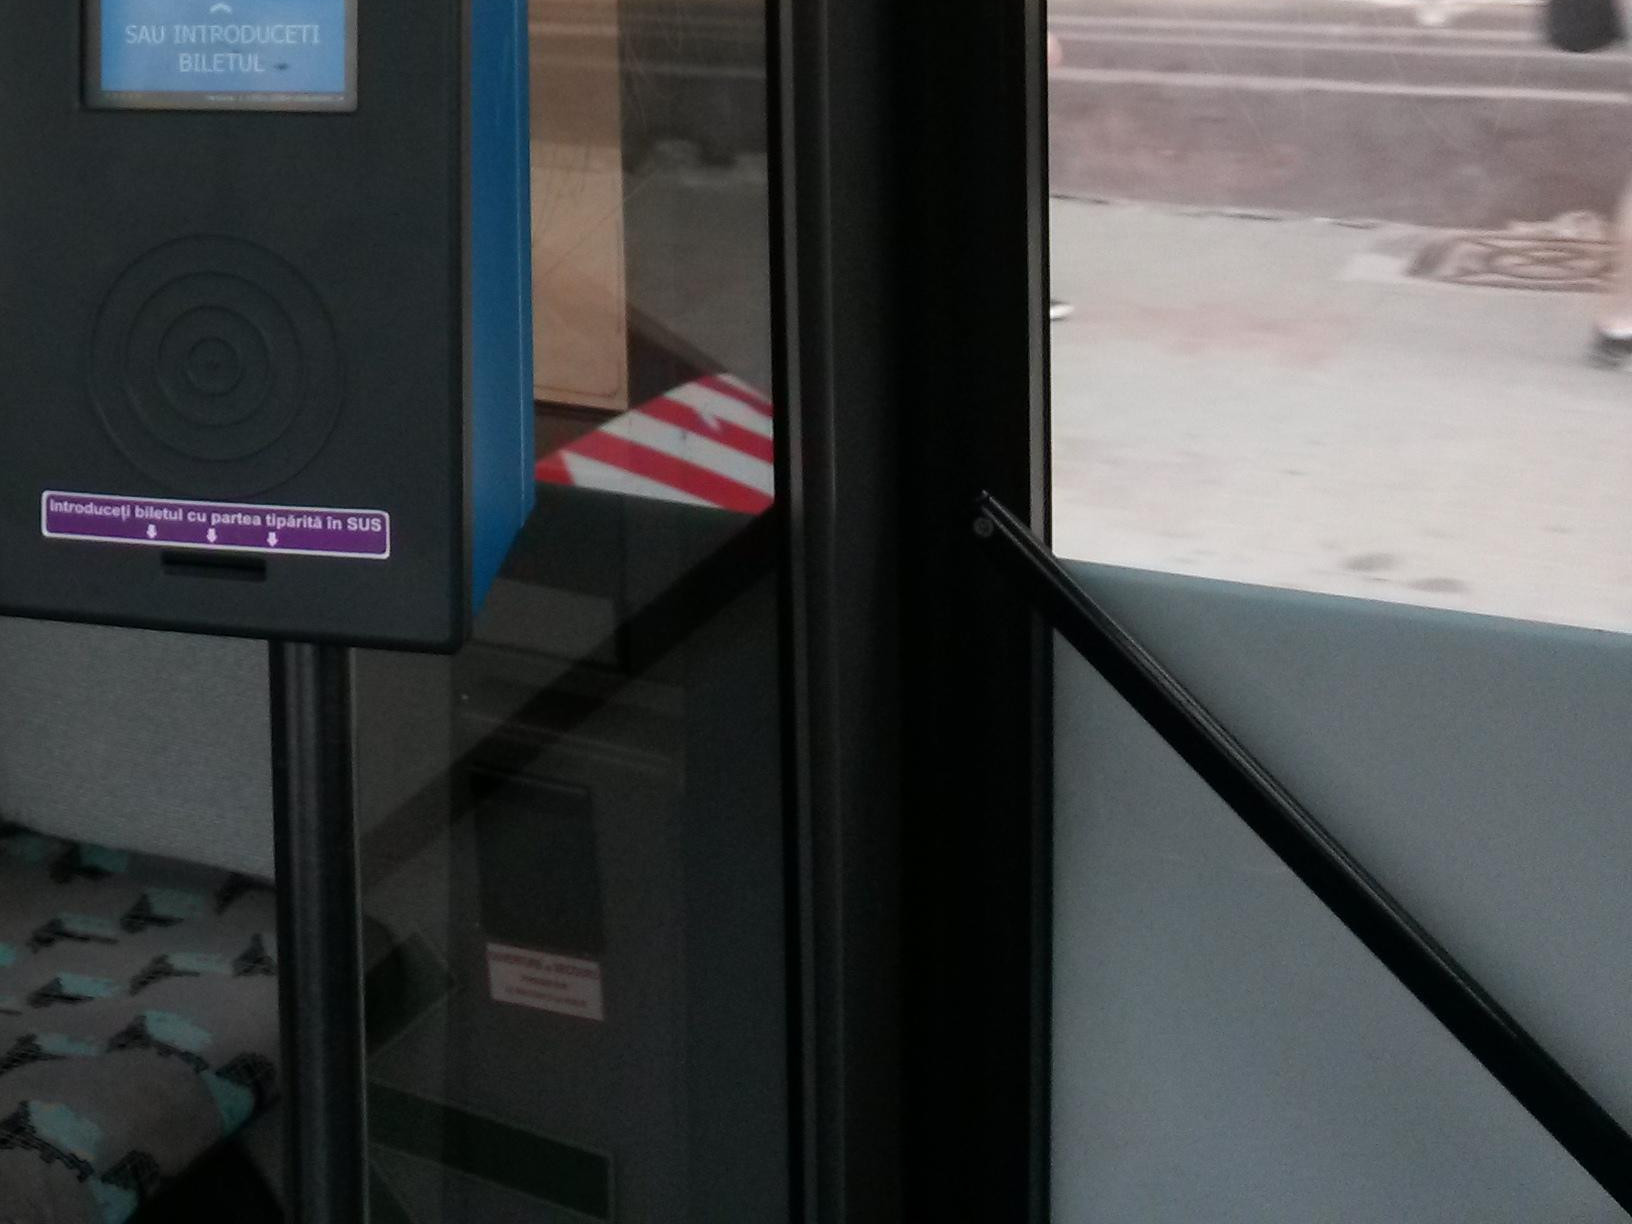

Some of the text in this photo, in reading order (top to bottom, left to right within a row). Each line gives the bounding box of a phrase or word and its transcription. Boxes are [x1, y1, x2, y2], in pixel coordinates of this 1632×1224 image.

[125, 24, 321, 44] SAU INTRODUCETI
[178, 53, 266, 72] BILETUL
[134, 504, 183, 522] biletul
[187, 510, 206, 523] cu
[211, 512, 262, 527] partea
[346, 517, 382, 532] SUS
